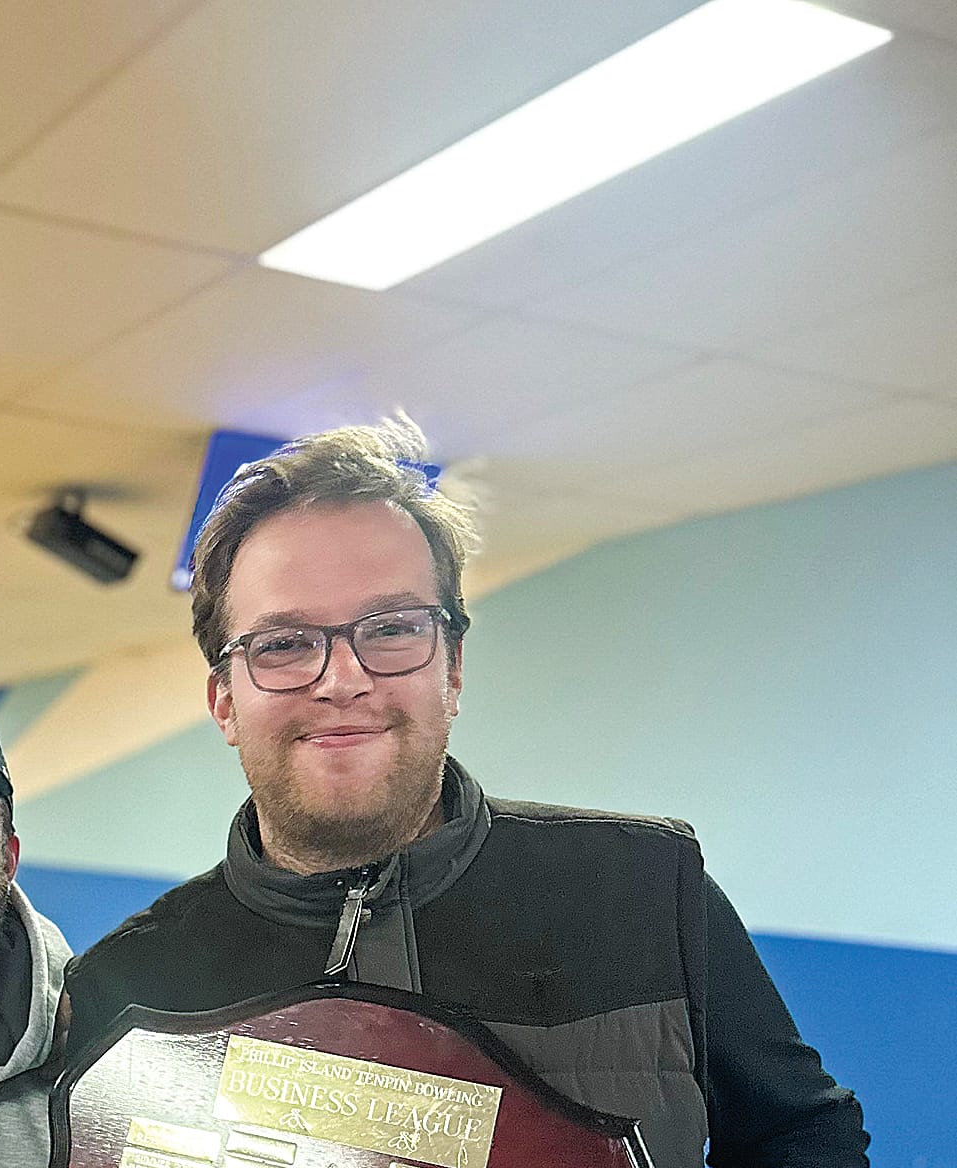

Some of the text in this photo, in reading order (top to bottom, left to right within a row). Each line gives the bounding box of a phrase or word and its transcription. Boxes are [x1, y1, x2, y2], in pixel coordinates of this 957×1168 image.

[228, 1070, 481, 1142] BUSINESS LEAGUE
[240, 1048, 483, 1106] PHILLIP ISLAND TENPIN BOWLING
